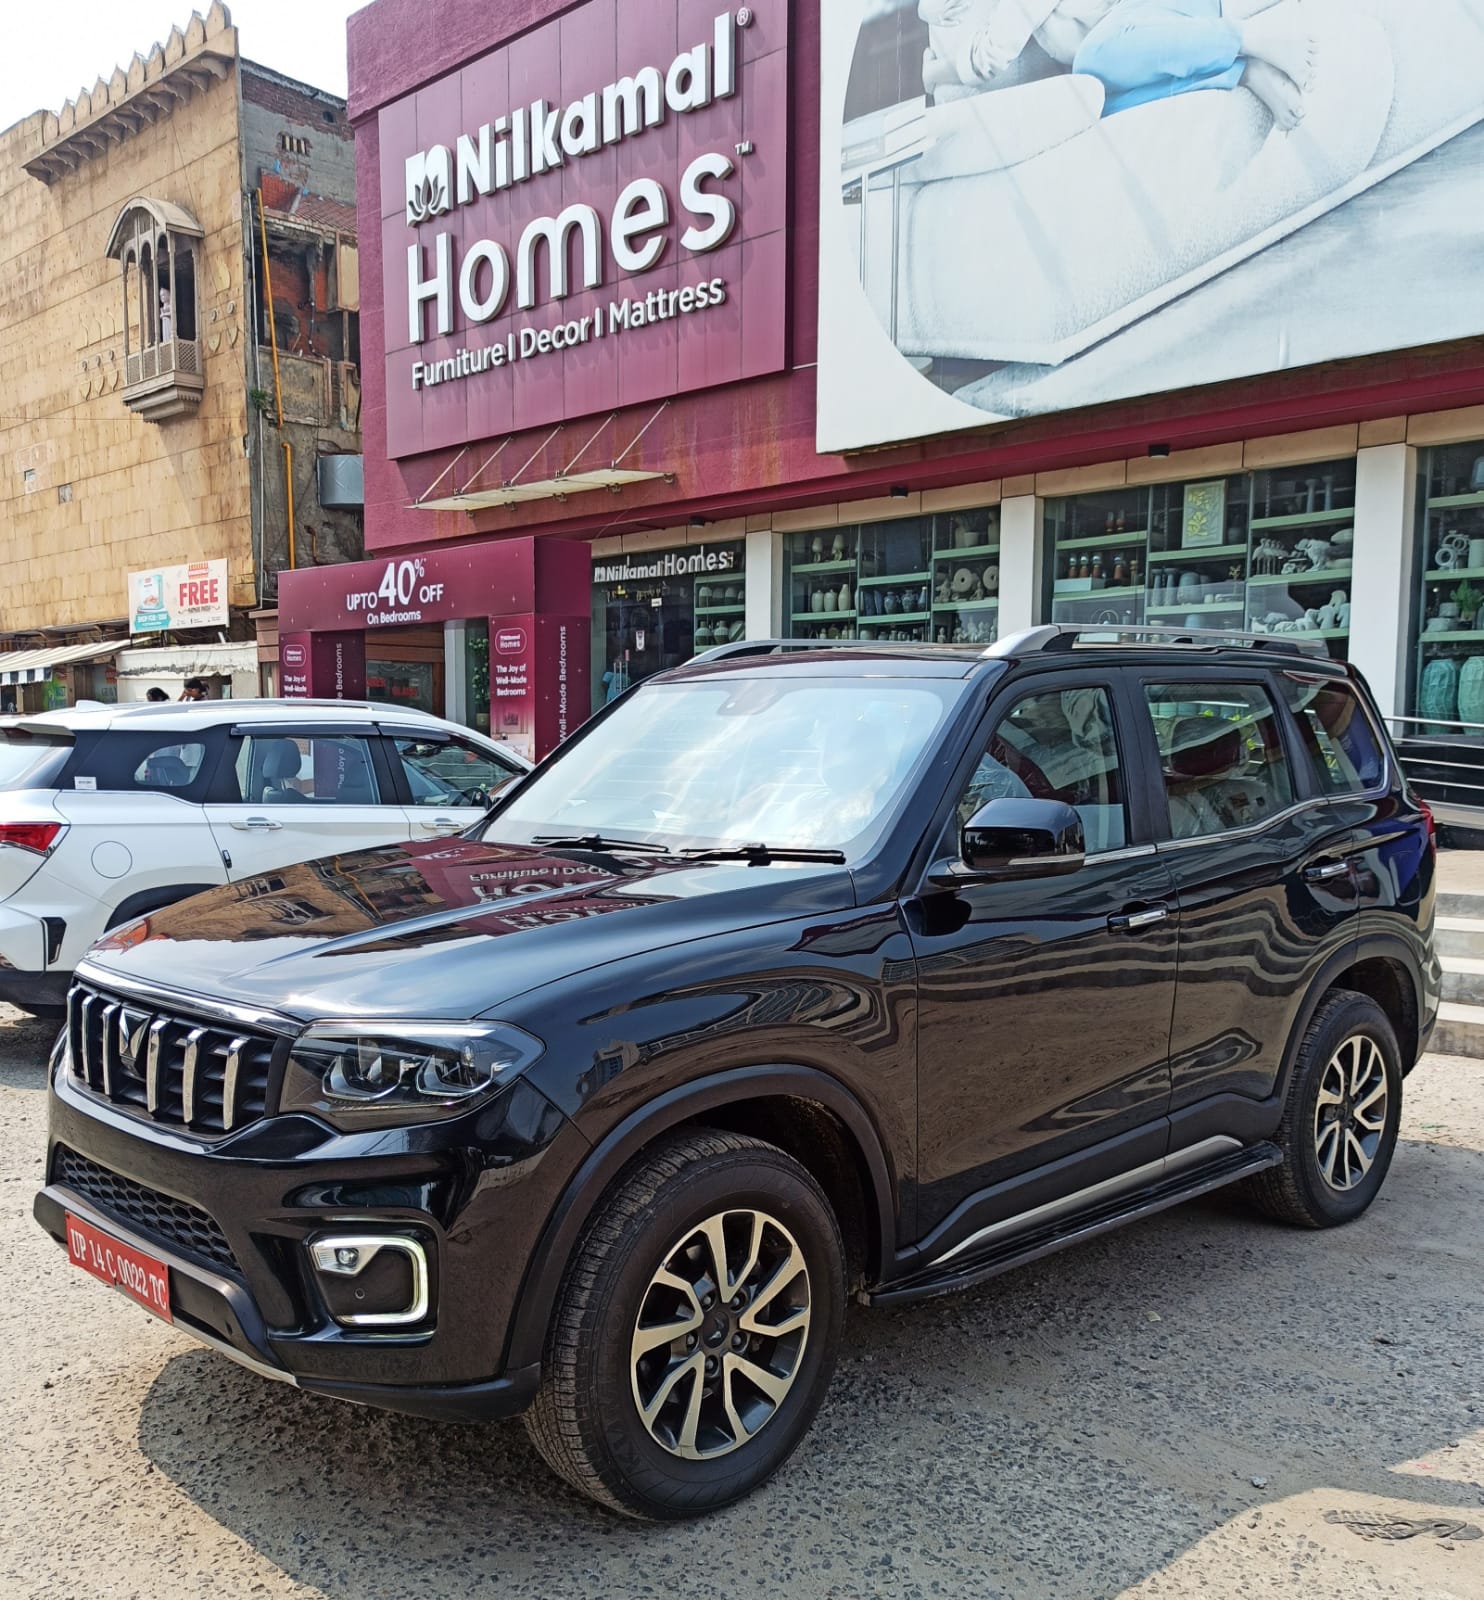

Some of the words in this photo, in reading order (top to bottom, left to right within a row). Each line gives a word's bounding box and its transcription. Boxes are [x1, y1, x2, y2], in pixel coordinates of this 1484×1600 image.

[411, 341, 507, 390] Furniture
[520, 315, 593, 359] Decor
[609, 277, 725, 334] Mattress
[606, 561, 662, 581] Nilkamal
[664, 551, 728, 576] Homes
[179, 578, 218, 607] FREE
[346, 592, 377, 610] UPTO
[419, 583, 444, 603] OFF
[367, 613, 379, 624] On
[380, 610, 421, 624] Bedrooms
[335, 643, 343, 690] Bedrooms
[496, 665, 507, 673] The
[508, 664, 518, 674] Joy
[496, 676, 527, 685] Well-Made
[496, 688, 526, 696] Bedrooms
[70, 1228, 87, 1261] UP
[89, 1239, 106, 1272] 14
[106, 1248, 116, 1278] C
[117, 1254, 148, 1298] 0022
[149, 1273, 166, 1310] TC
